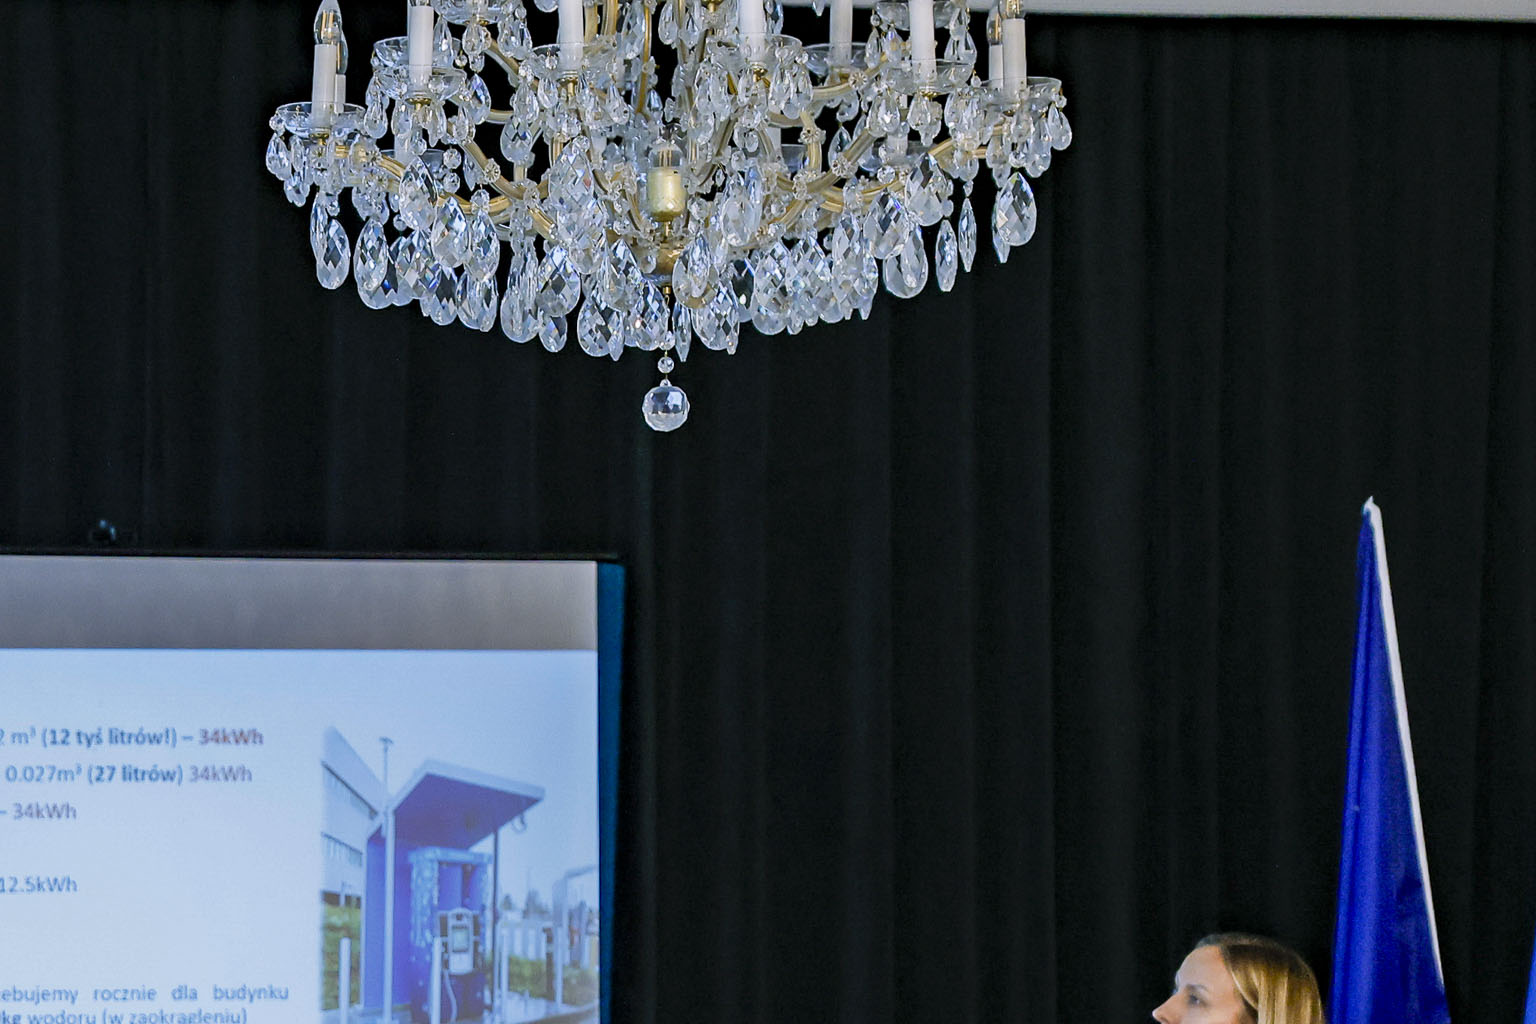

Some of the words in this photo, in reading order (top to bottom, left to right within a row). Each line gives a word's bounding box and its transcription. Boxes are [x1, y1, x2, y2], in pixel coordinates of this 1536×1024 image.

[41, 728, 71, 749] (12
[108, 727, 178, 749] litrów!)
[199, 727, 264, 746] 34kWh
[87, 764, 117, 785] (27
[121, 764, 184, 786] litrów)
[189, 764, 253, 783] 34kWh
[12, 801, 77, 820] 34kWh
[92, 984, 158, 1002] rocznie
[170, 984, 198, 1002] dla
[212, 983, 289, 1004] budynku
